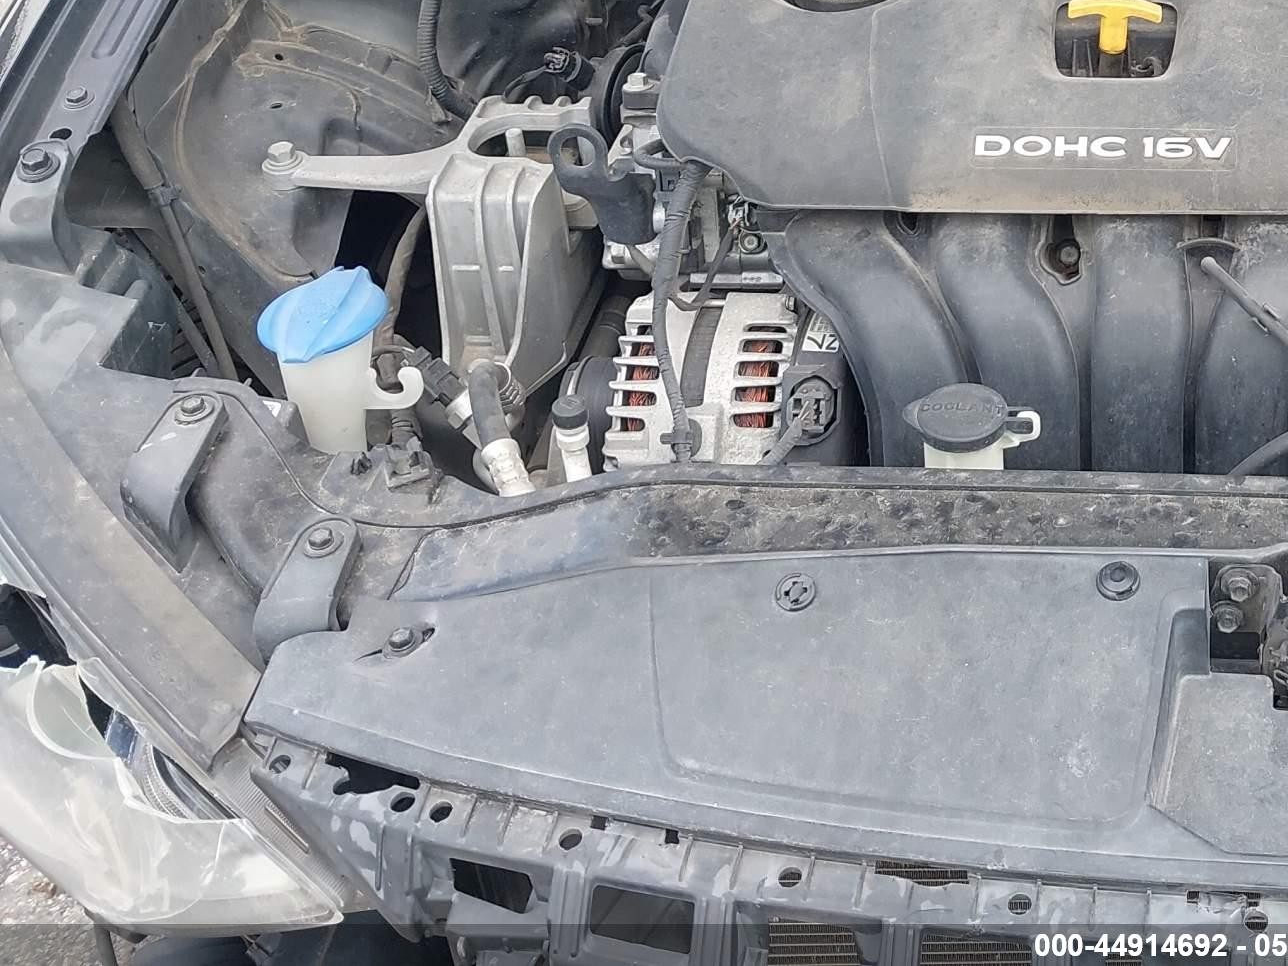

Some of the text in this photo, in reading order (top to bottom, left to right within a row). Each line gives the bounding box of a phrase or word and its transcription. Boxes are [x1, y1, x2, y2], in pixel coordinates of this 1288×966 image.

[975, 135, 1232, 159] DOHC 16V
[921, 402, 1004, 418] COOLANT
